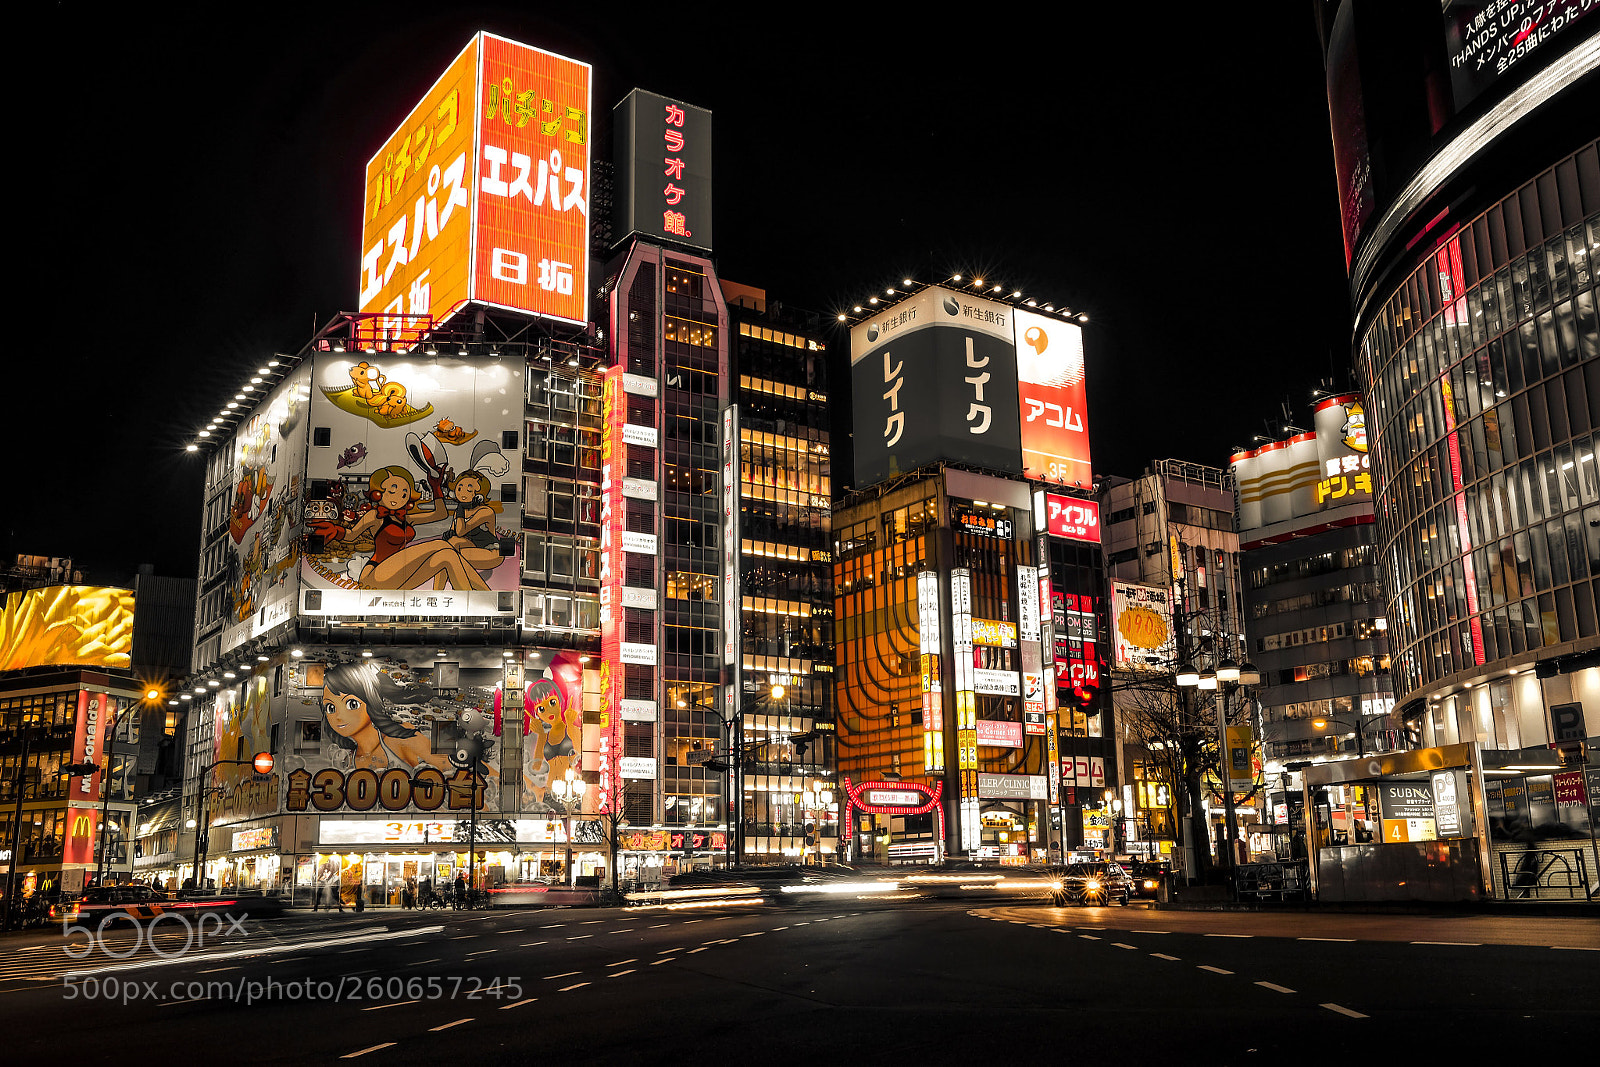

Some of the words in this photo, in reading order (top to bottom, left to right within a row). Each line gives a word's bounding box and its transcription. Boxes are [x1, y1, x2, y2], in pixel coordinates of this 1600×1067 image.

[486, 77, 586, 146] パチンコ
[372, 89, 459, 220] パチンコ
[481, 144, 586, 216] エスパス
[360, 152, 468, 307] エスパス
[491, 247, 573, 296] 日拓
[881, 306, 917, 334] 新生銀行
[963, 304, 1006, 327] 新生銀行
[883, 351, 905, 448] レイク
[965, 336, 992, 434] レイク
[603, 376, 612, 460] パチンコ
[1024, 397, 1084, 433] アコム
[1049, 462, 1067, 480] 3F
[1049, 502, 1097, 527] アイフル
[411, 597, 454, 607] 北電子
[1056, 661, 1097, 680] アイフル
[1062, 761, 1104, 777] アコム
[1392, 824, 1402, 841] 4
